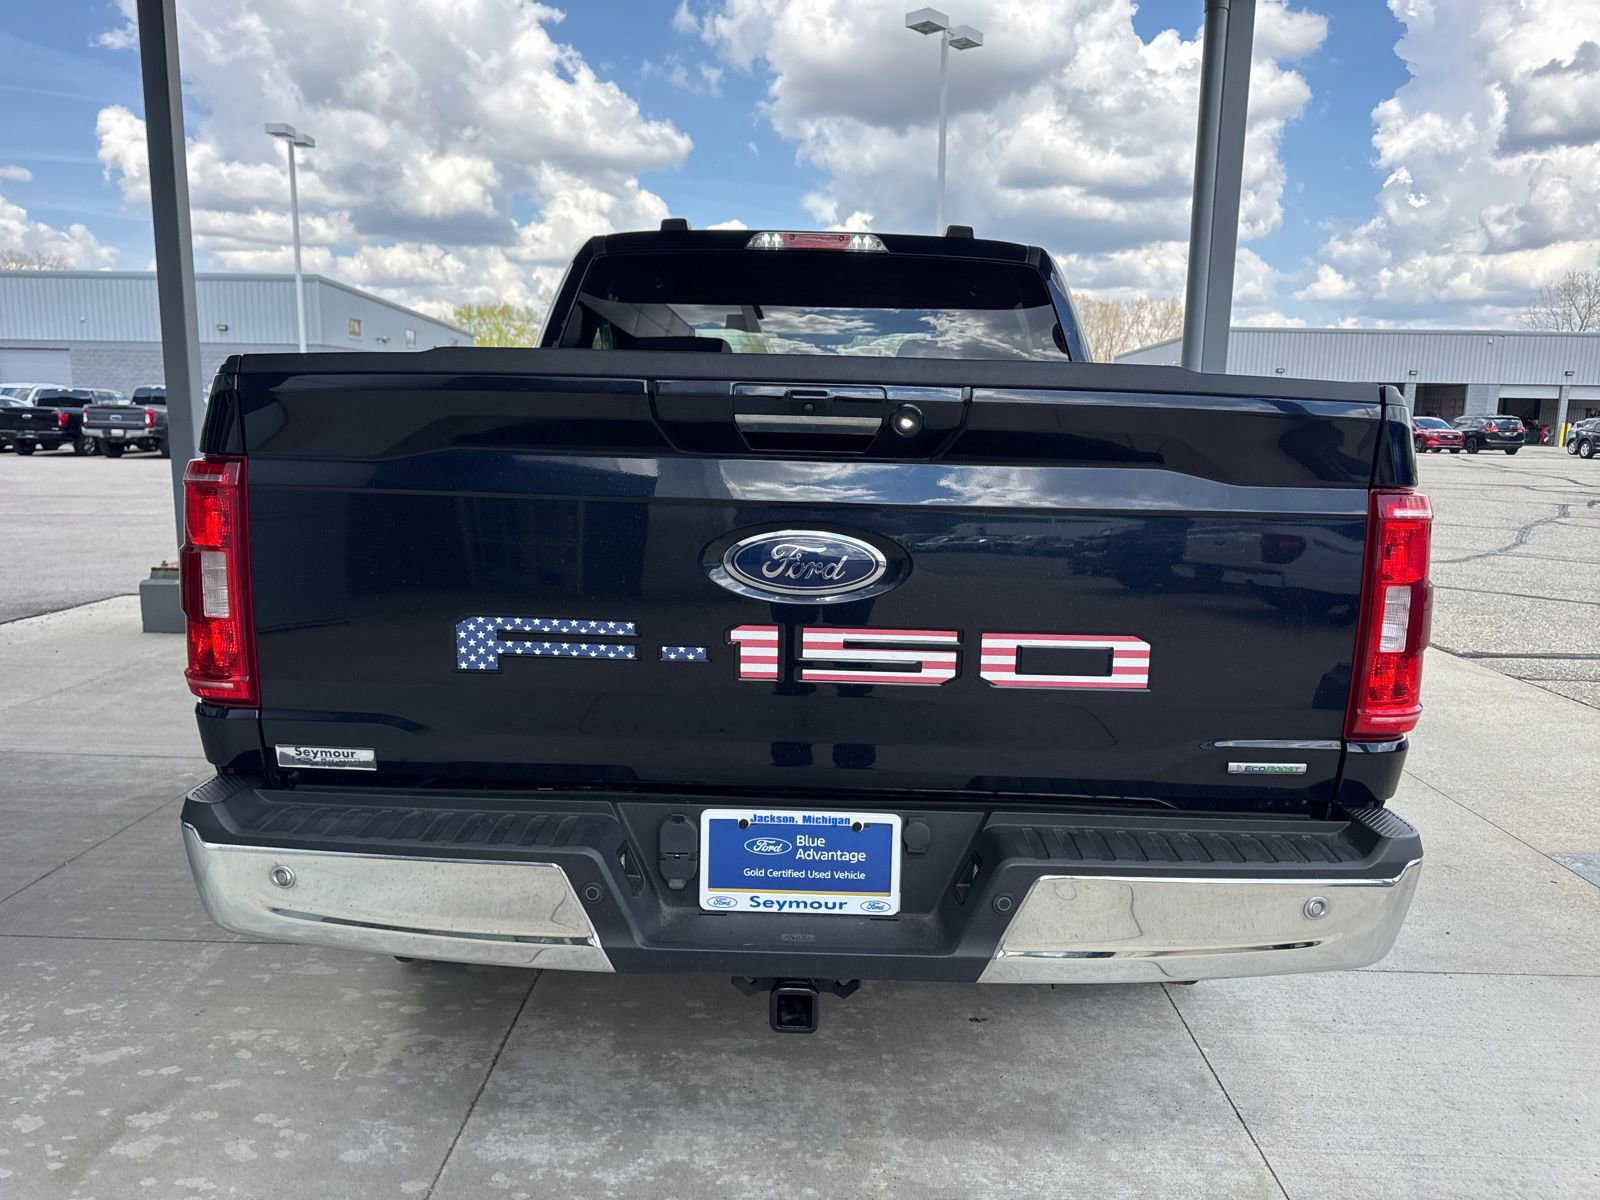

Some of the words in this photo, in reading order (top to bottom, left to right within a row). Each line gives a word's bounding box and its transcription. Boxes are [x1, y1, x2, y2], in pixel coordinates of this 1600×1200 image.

[762, 544, 848, 580] Ford
[455, 616, 1151, 690] F-150
[294, 746, 356, 759] Seymour
[802, 815, 850, 826] Michigan
[753, 840, 783, 852] Ford
[796, 835, 825, 847] Blue
[796, 848, 866, 863] Advantage
[743, 868, 764, 877] Gold
[767, 868, 805, 878] Certified
[808, 870, 831, 879] Used
[834, 871, 866, 880] Vehicle
[712, 896, 732, 906] Ford
[749, 895, 848, 911] Seymour
[866, 901, 886, 911] Ford
